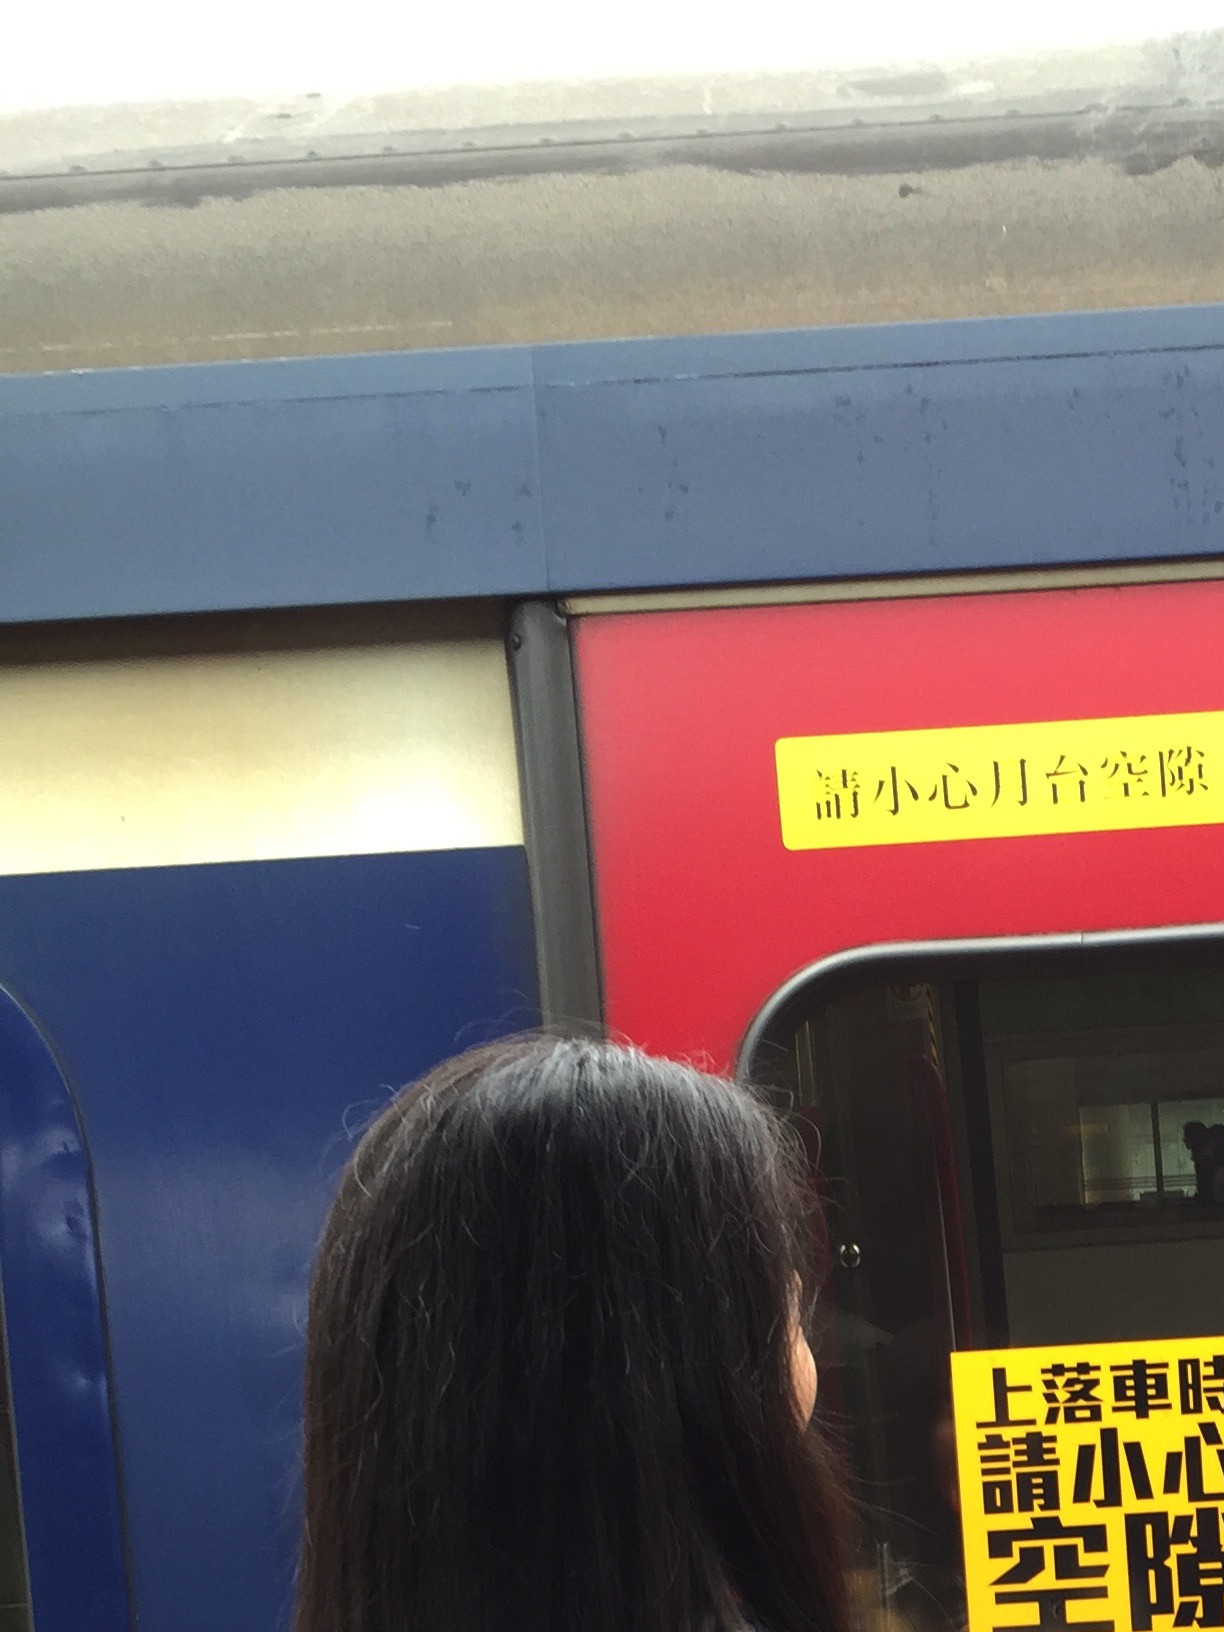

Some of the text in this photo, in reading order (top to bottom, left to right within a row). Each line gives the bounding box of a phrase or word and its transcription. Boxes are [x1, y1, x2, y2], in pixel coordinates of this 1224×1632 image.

[815, 745, 1210, 821] 請小心月台空隙
